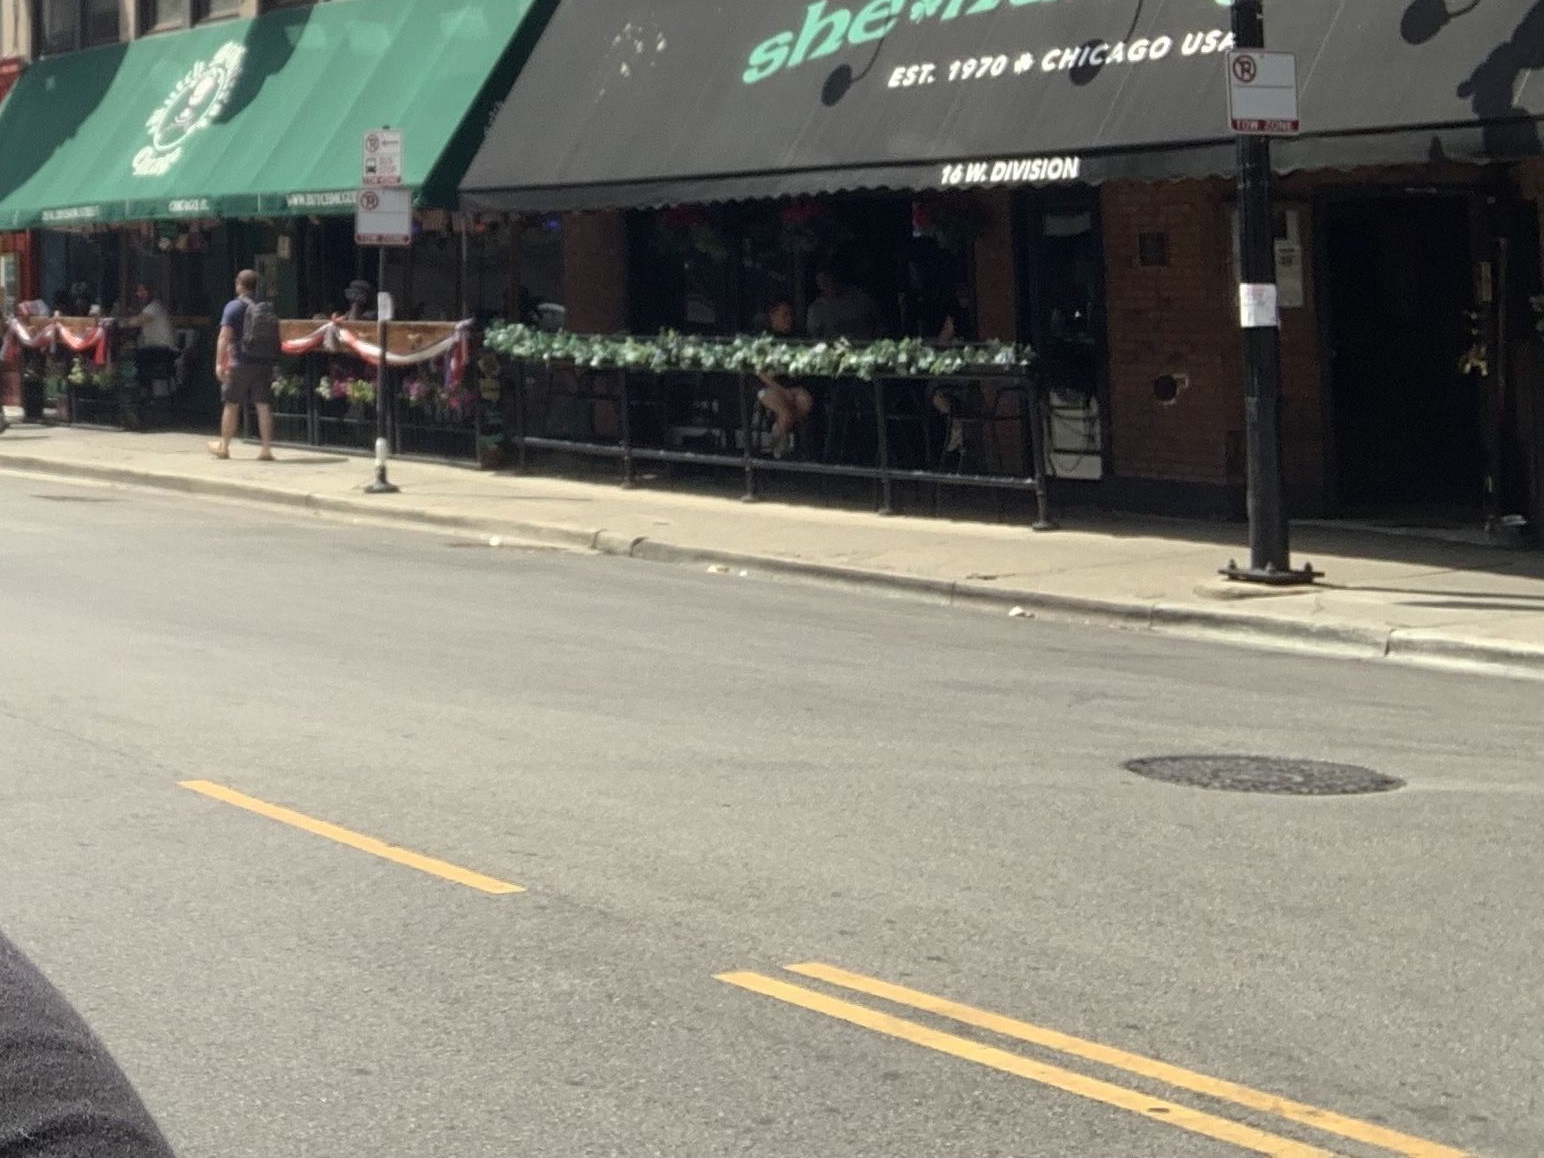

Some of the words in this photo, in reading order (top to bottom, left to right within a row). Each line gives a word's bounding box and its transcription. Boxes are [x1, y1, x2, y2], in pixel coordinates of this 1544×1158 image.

[887, 62, 936, 88] EST.
[948, 54, 1008, 82] 1970
[1041, 35, 1173, 71] CHICAGO
[1181, 29, 1237, 55] USA
[1236, 121, 1258, 132] TOW
[1266, 121, 1291, 132] ZONE
[941, 163, 964, 185] 16
[965, 161, 988, 183] W.
[989, 156, 1081, 182] DIVISION
